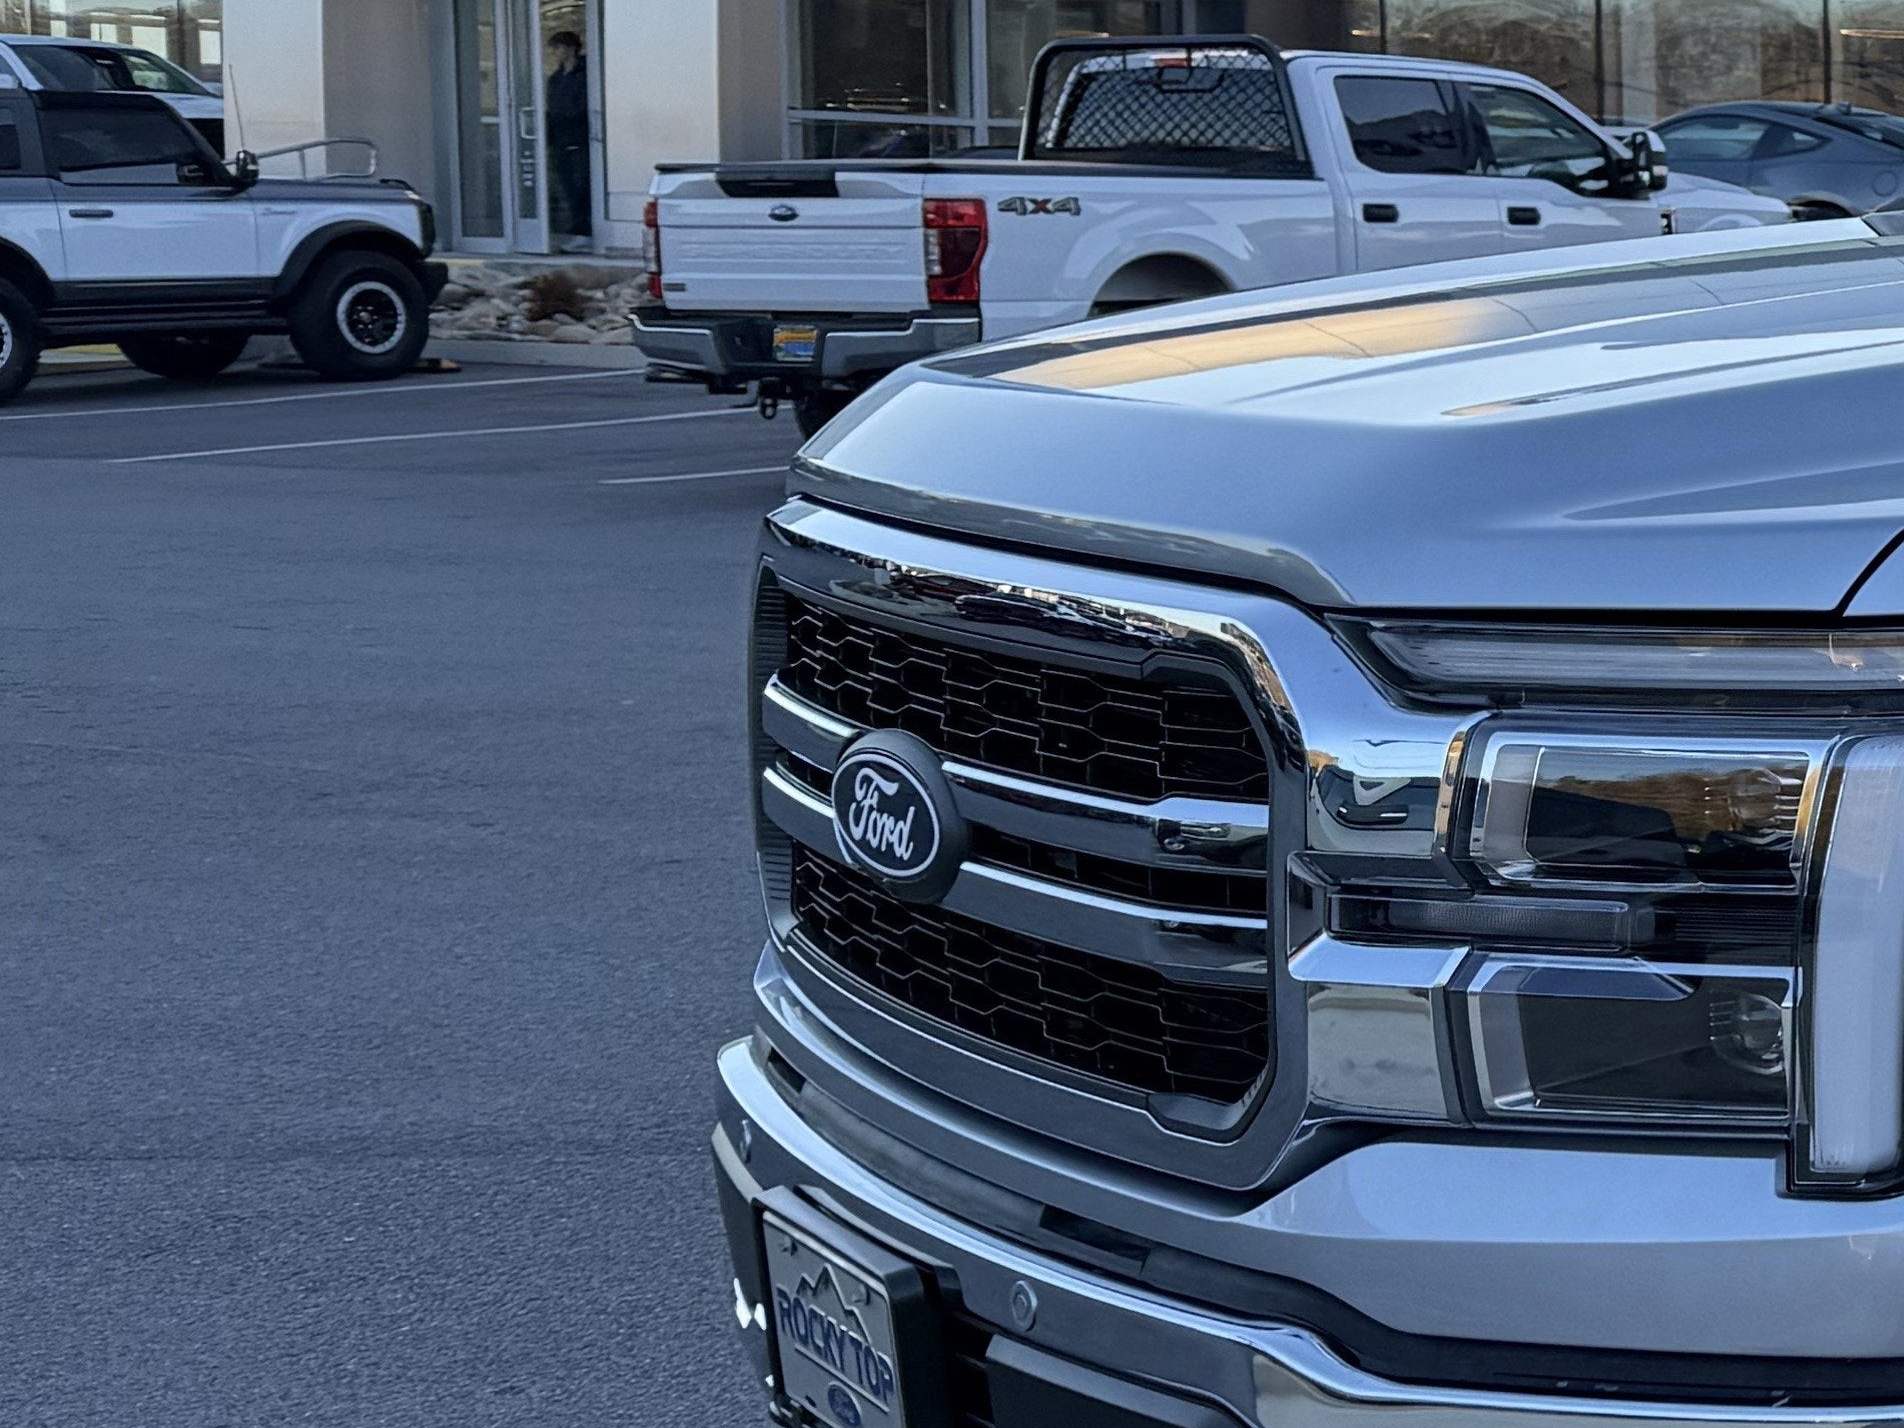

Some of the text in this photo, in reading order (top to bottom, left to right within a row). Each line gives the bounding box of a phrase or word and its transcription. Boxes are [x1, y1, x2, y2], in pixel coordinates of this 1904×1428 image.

[849, 767, 916, 861] Ford
[776, 1283, 894, 1406] ROCKY TOP
